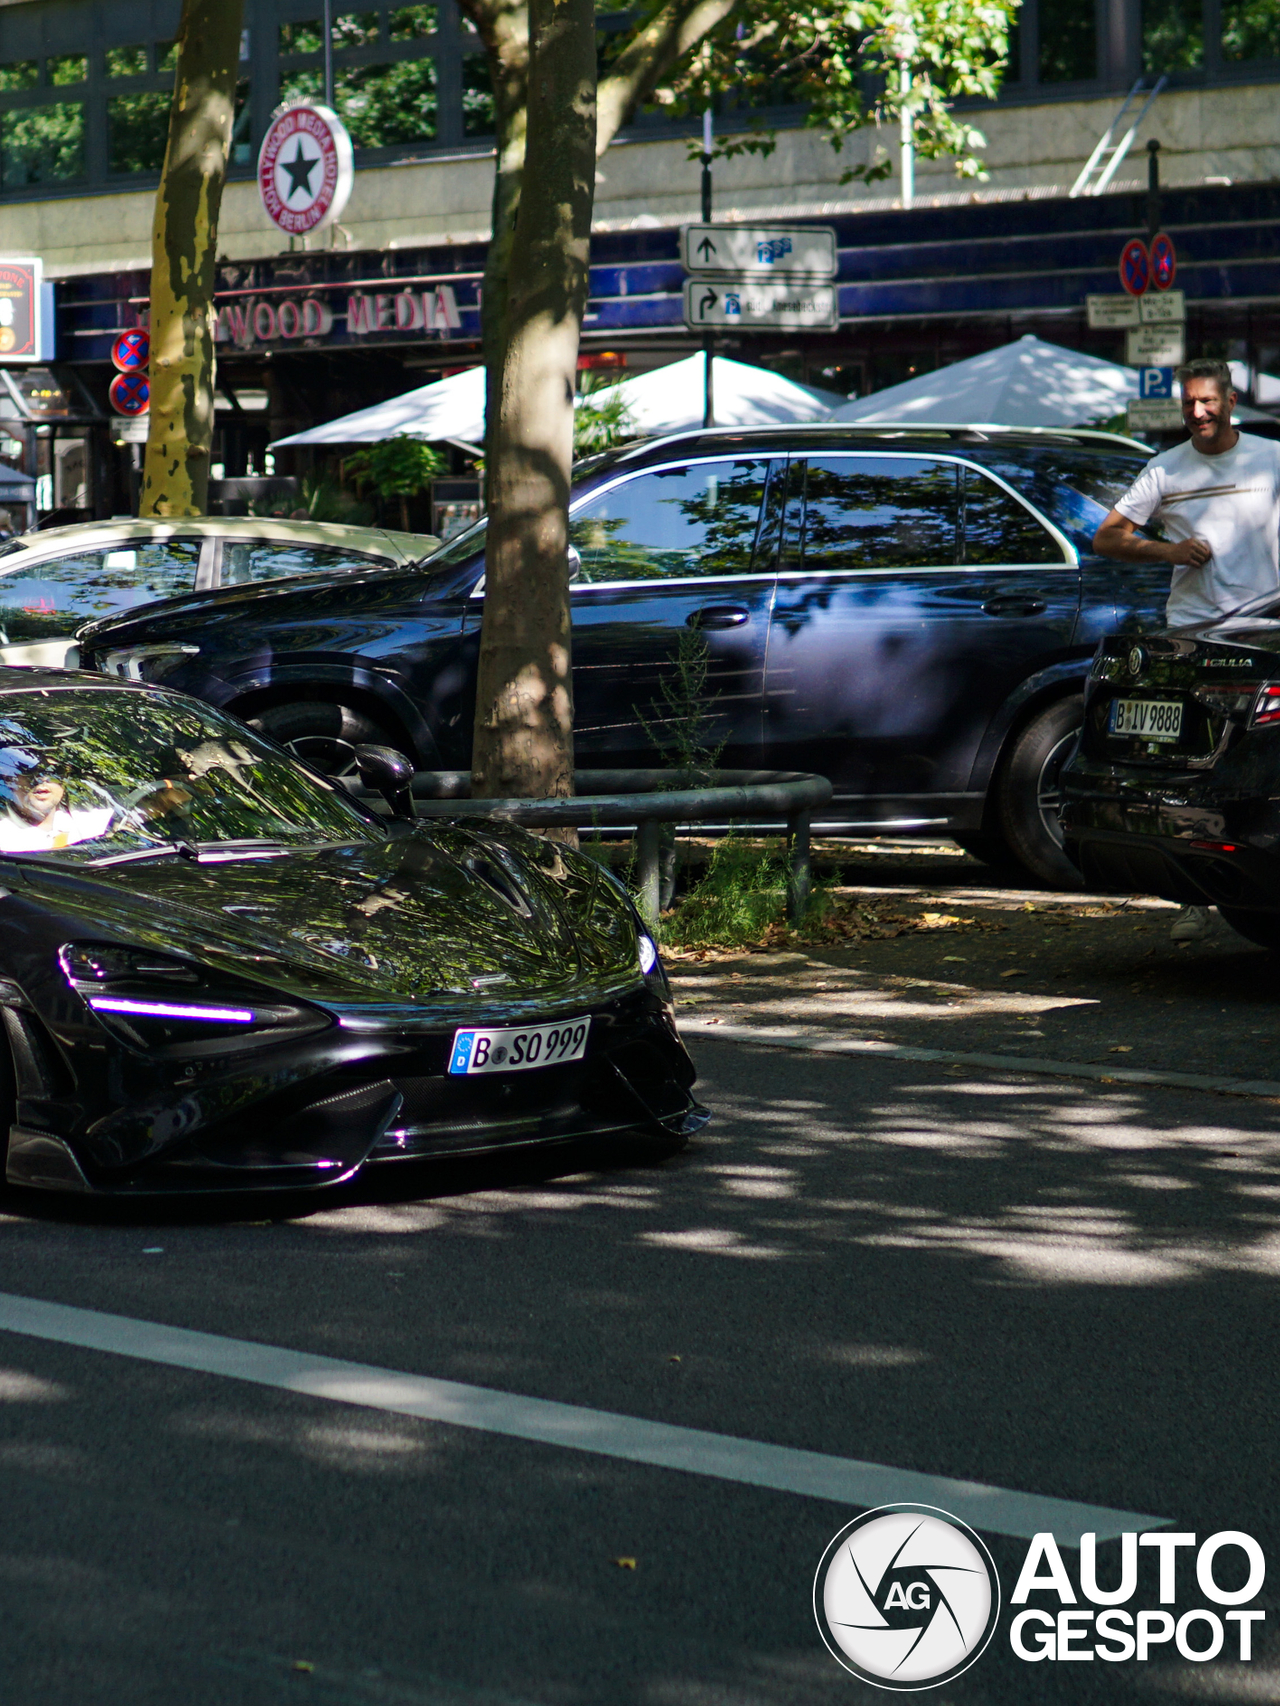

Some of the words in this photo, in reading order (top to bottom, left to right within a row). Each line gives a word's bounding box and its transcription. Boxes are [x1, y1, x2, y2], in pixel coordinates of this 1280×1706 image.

[296, 112, 331, 150] MEDIA
[277, 206, 322, 231] BERLIN
[347, 288, 454, 334] MEDIA
[1210, 658, 1253, 668] GIULIA
[1116, 703, 1126, 730] B
[1149, 704, 1181, 733] 9888
[472, 1037, 491, 1068] B
